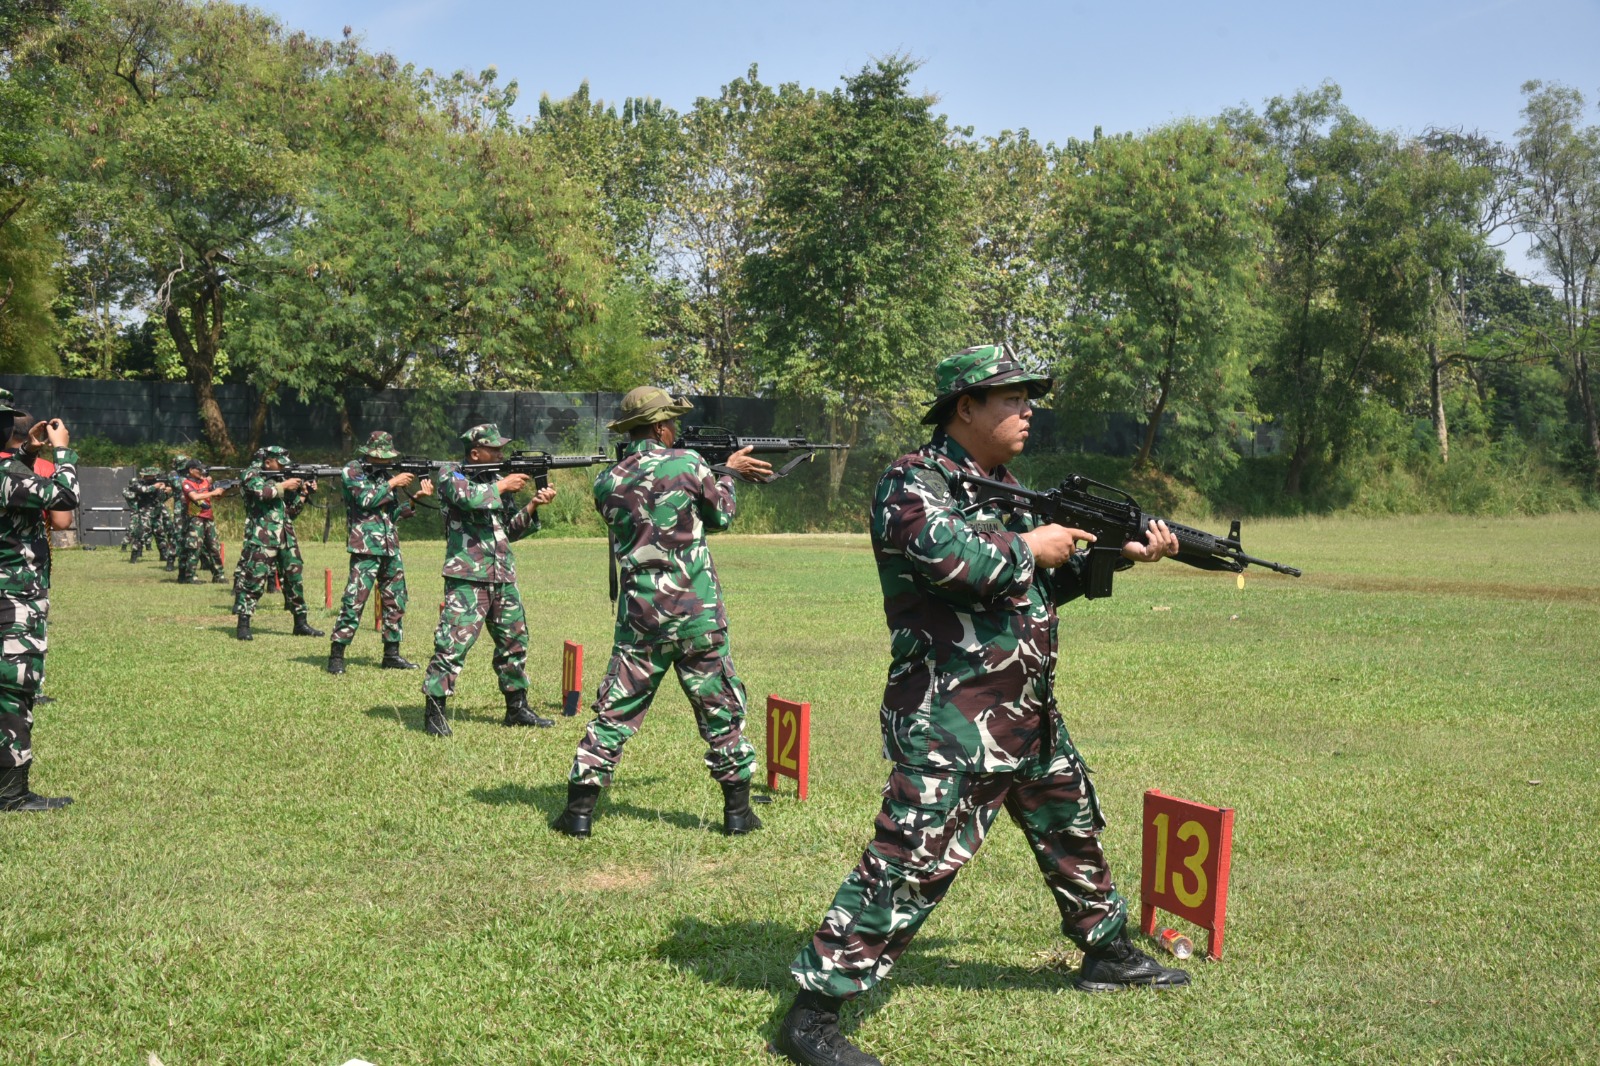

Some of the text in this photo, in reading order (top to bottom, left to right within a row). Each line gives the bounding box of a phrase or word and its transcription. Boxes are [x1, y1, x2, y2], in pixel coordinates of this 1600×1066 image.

[564, 650, 574, 691] 11
[771, 708, 797, 770] 12
[1152, 812, 1210, 908] 13
